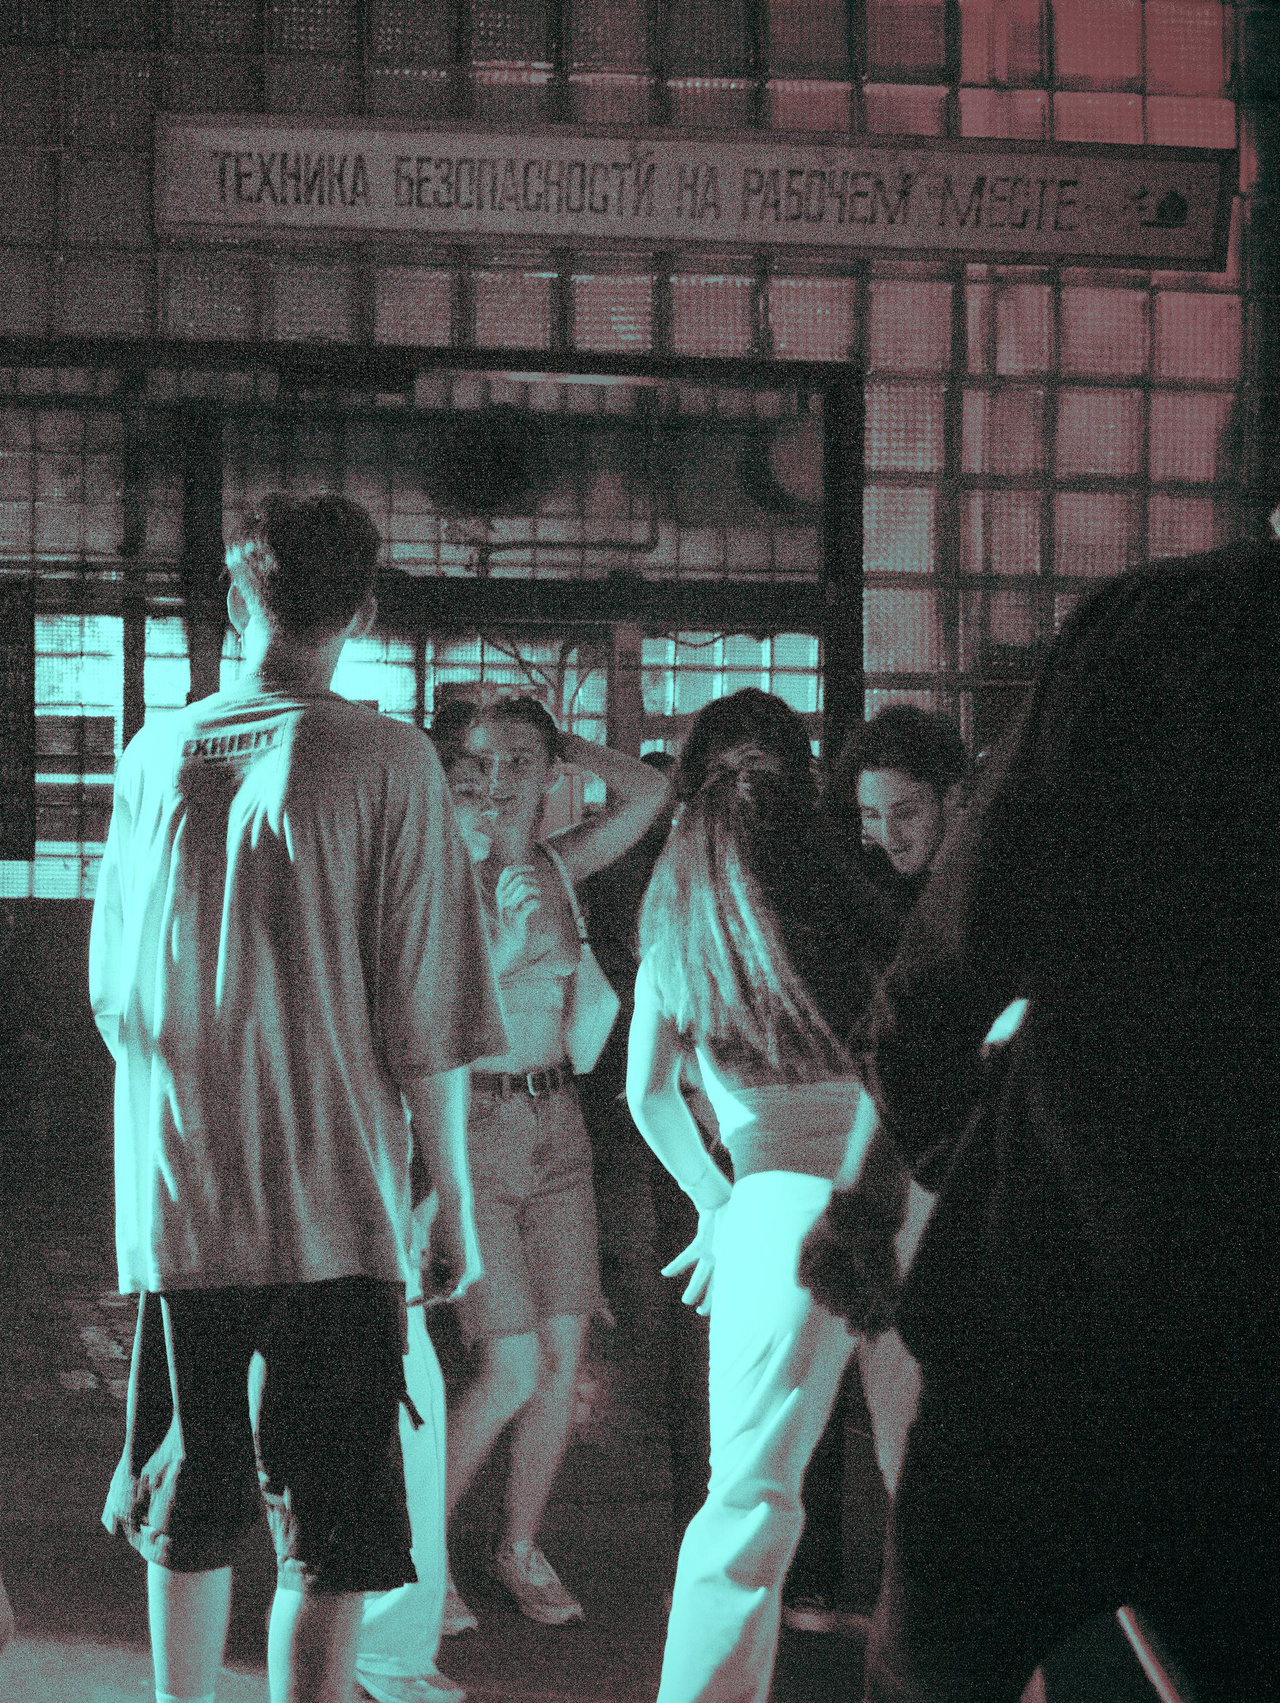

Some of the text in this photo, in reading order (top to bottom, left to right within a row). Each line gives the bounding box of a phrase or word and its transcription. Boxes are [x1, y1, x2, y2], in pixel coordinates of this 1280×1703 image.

[211, 149, 368, 206] ТЕХНИКА
[675, 160, 722, 220] НА
[741, 165, 914, 225] РАБОЧЕМ
[938, 175, 1079, 231] МЕСТЕ
[183, 726, 278, 758] EXHIBIT
